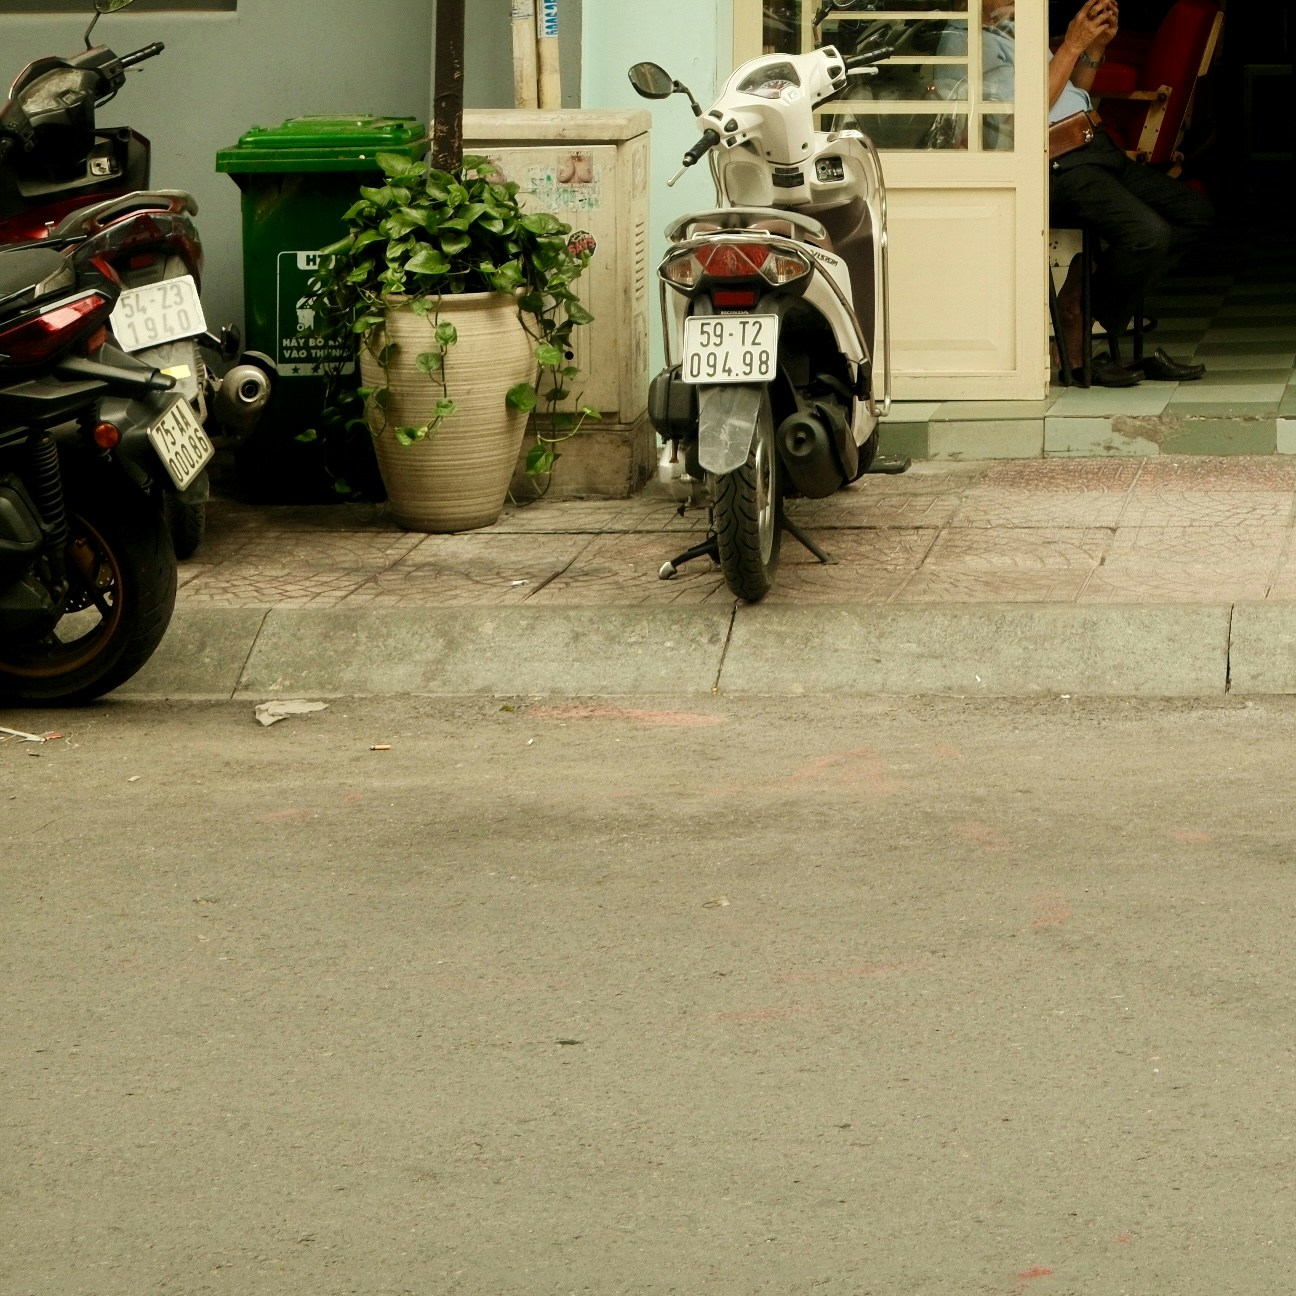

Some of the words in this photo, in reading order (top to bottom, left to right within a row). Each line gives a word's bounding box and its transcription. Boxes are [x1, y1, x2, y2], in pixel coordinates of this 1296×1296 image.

[127, 309, 192, 344] 1940
[700, 321, 763, 347] 59-T2
[689, 350, 770, 378] 094.98
[169, 427, 209, 483] 000.86
